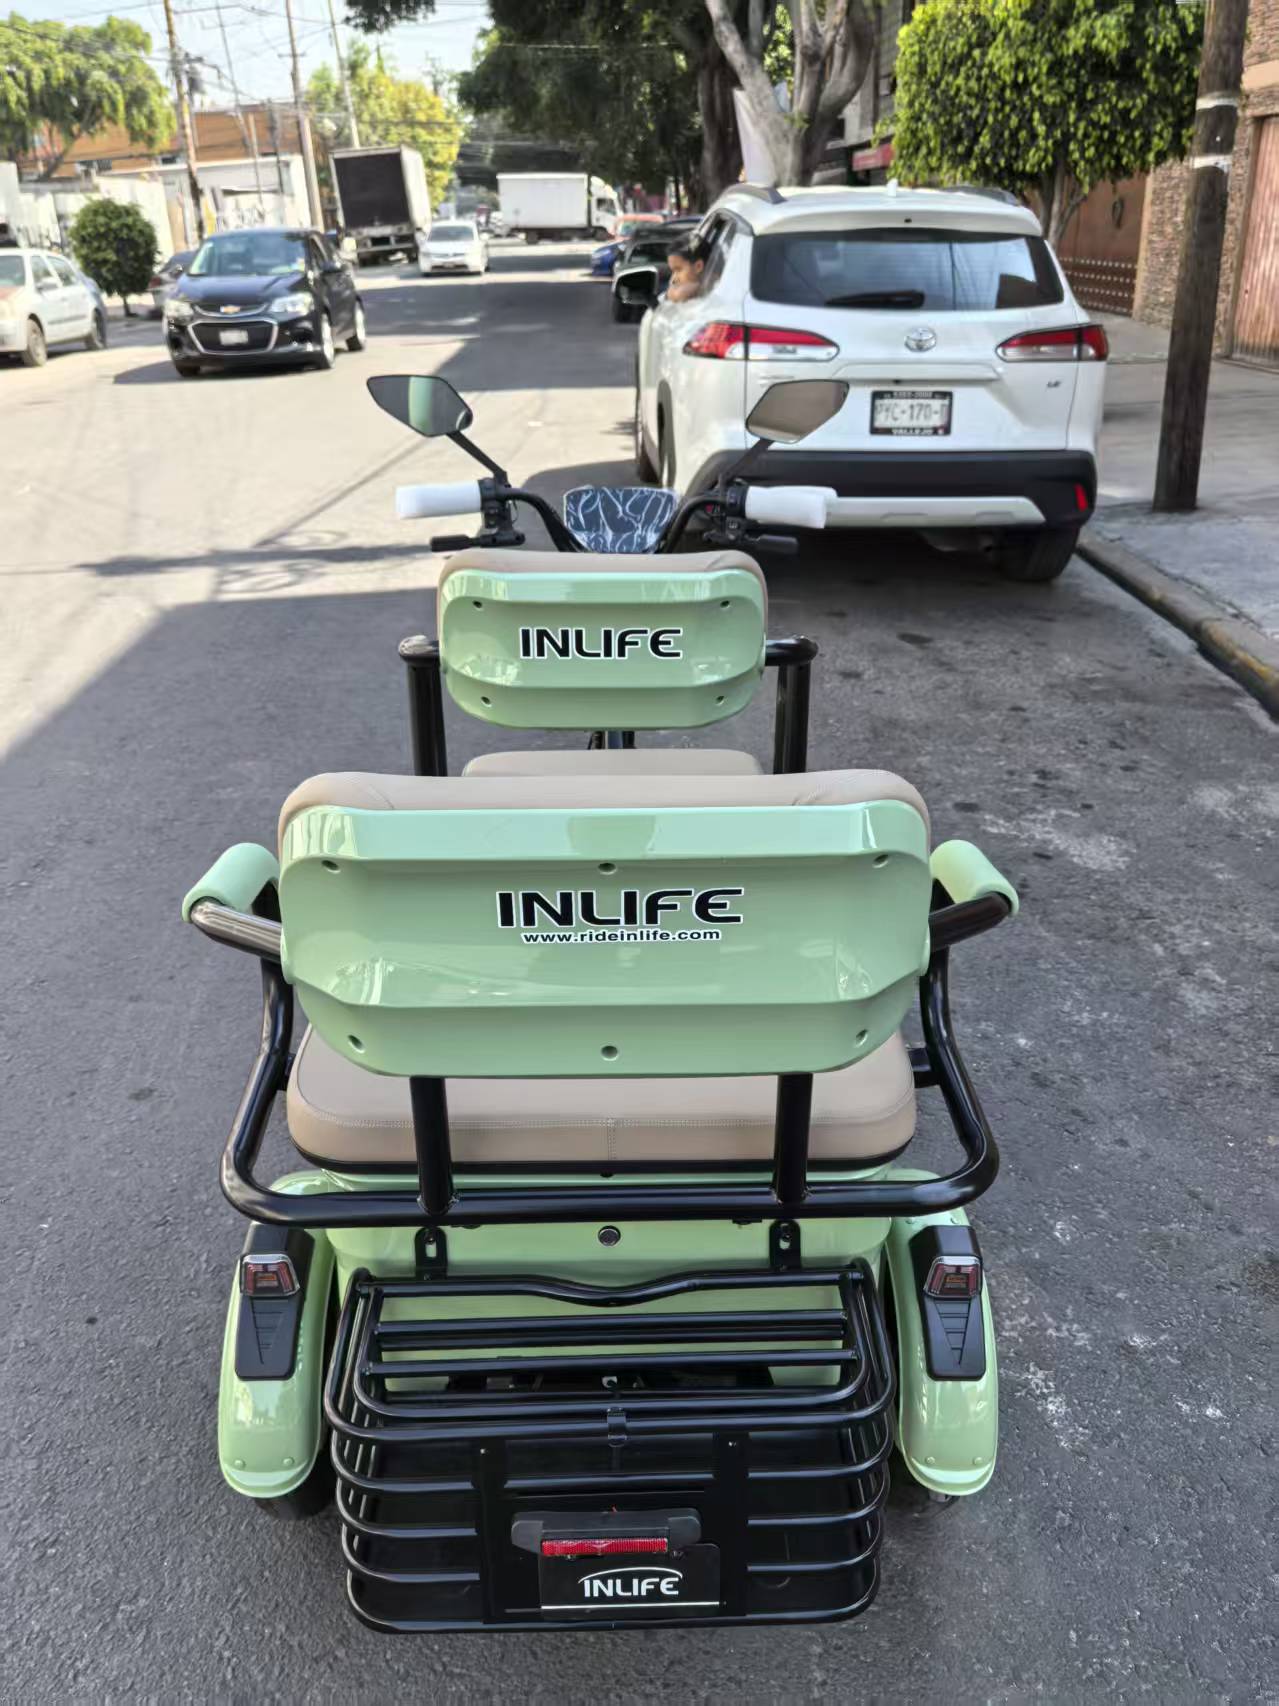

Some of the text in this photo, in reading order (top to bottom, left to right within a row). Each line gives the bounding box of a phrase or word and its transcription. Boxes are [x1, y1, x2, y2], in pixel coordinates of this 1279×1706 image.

[519, 627, 683, 659] INLIFE
[497, 888, 744, 928] INLIFE
[522, 929, 722, 943] www.rideinlife.com
[583, 1577, 679, 1597] INLIFE
